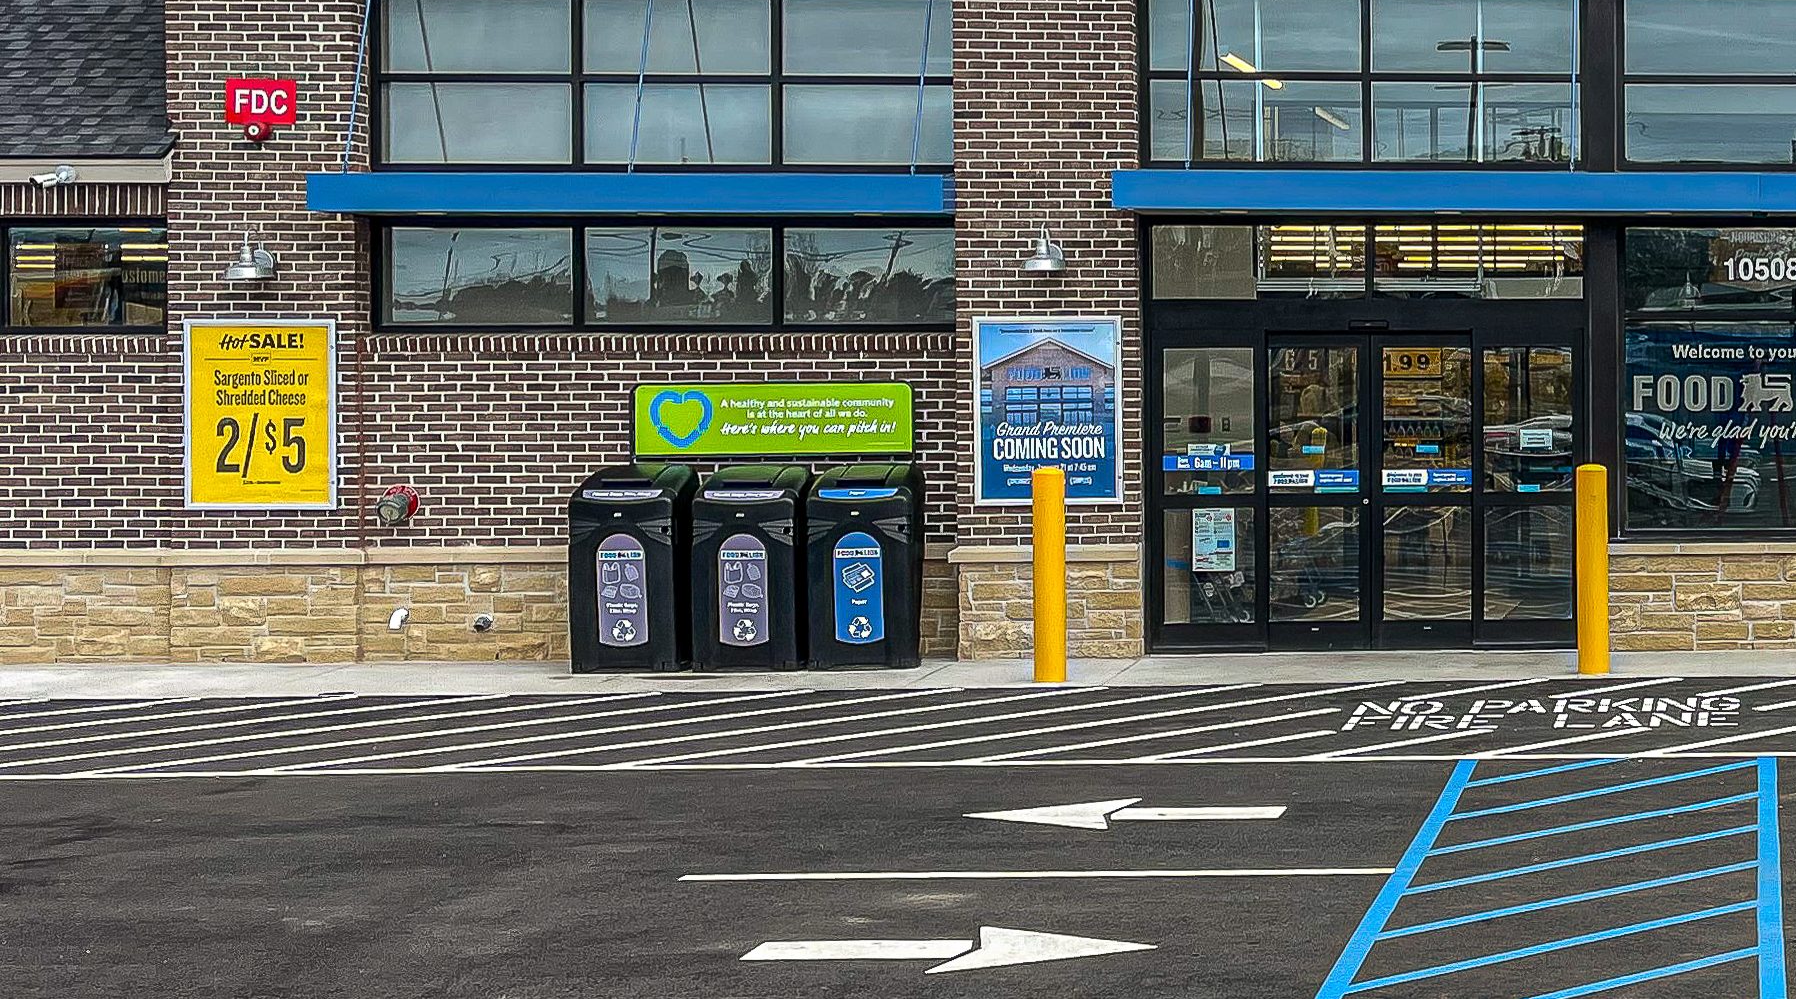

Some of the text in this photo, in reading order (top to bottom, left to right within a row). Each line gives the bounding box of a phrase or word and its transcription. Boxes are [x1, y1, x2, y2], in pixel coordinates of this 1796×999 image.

[234, 89, 288, 114] FDC
[219, 333, 305, 350] Hot SALE!
[1672, 344, 1745, 359] Welcome
[1749, 346, 1765, 359] to
[214, 369, 309, 389] Sargento Sliced or
[216, 389, 306, 406] Shredded Cheese
[1632, 374, 1734, 412] FOOD
[720, 398, 895, 409] A healthy and sustainable community
[747, 410, 756, 418] is
[757, 410, 768, 418] at
[769, 410, 784, 418] the
[786, 409, 811, 418] heart
[813, 409, 824, 418] of
[824, 409, 836, 418] all
[853, 409, 868, 418] do.
[720, 419, 897, 441] Here's where you can pitch in!
[997, 421, 1103, 436] Grand Premiere
[1659, 421, 1709, 441] We're
[1711, 419, 1753, 449] glad
[216, 413, 306, 479] 2/$5
[993, 437, 1106, 460] COMING SOON
[1352, 697, 1741, 716] NO PARKING
[1341, 711, 1740, 731] FIRE LANE
